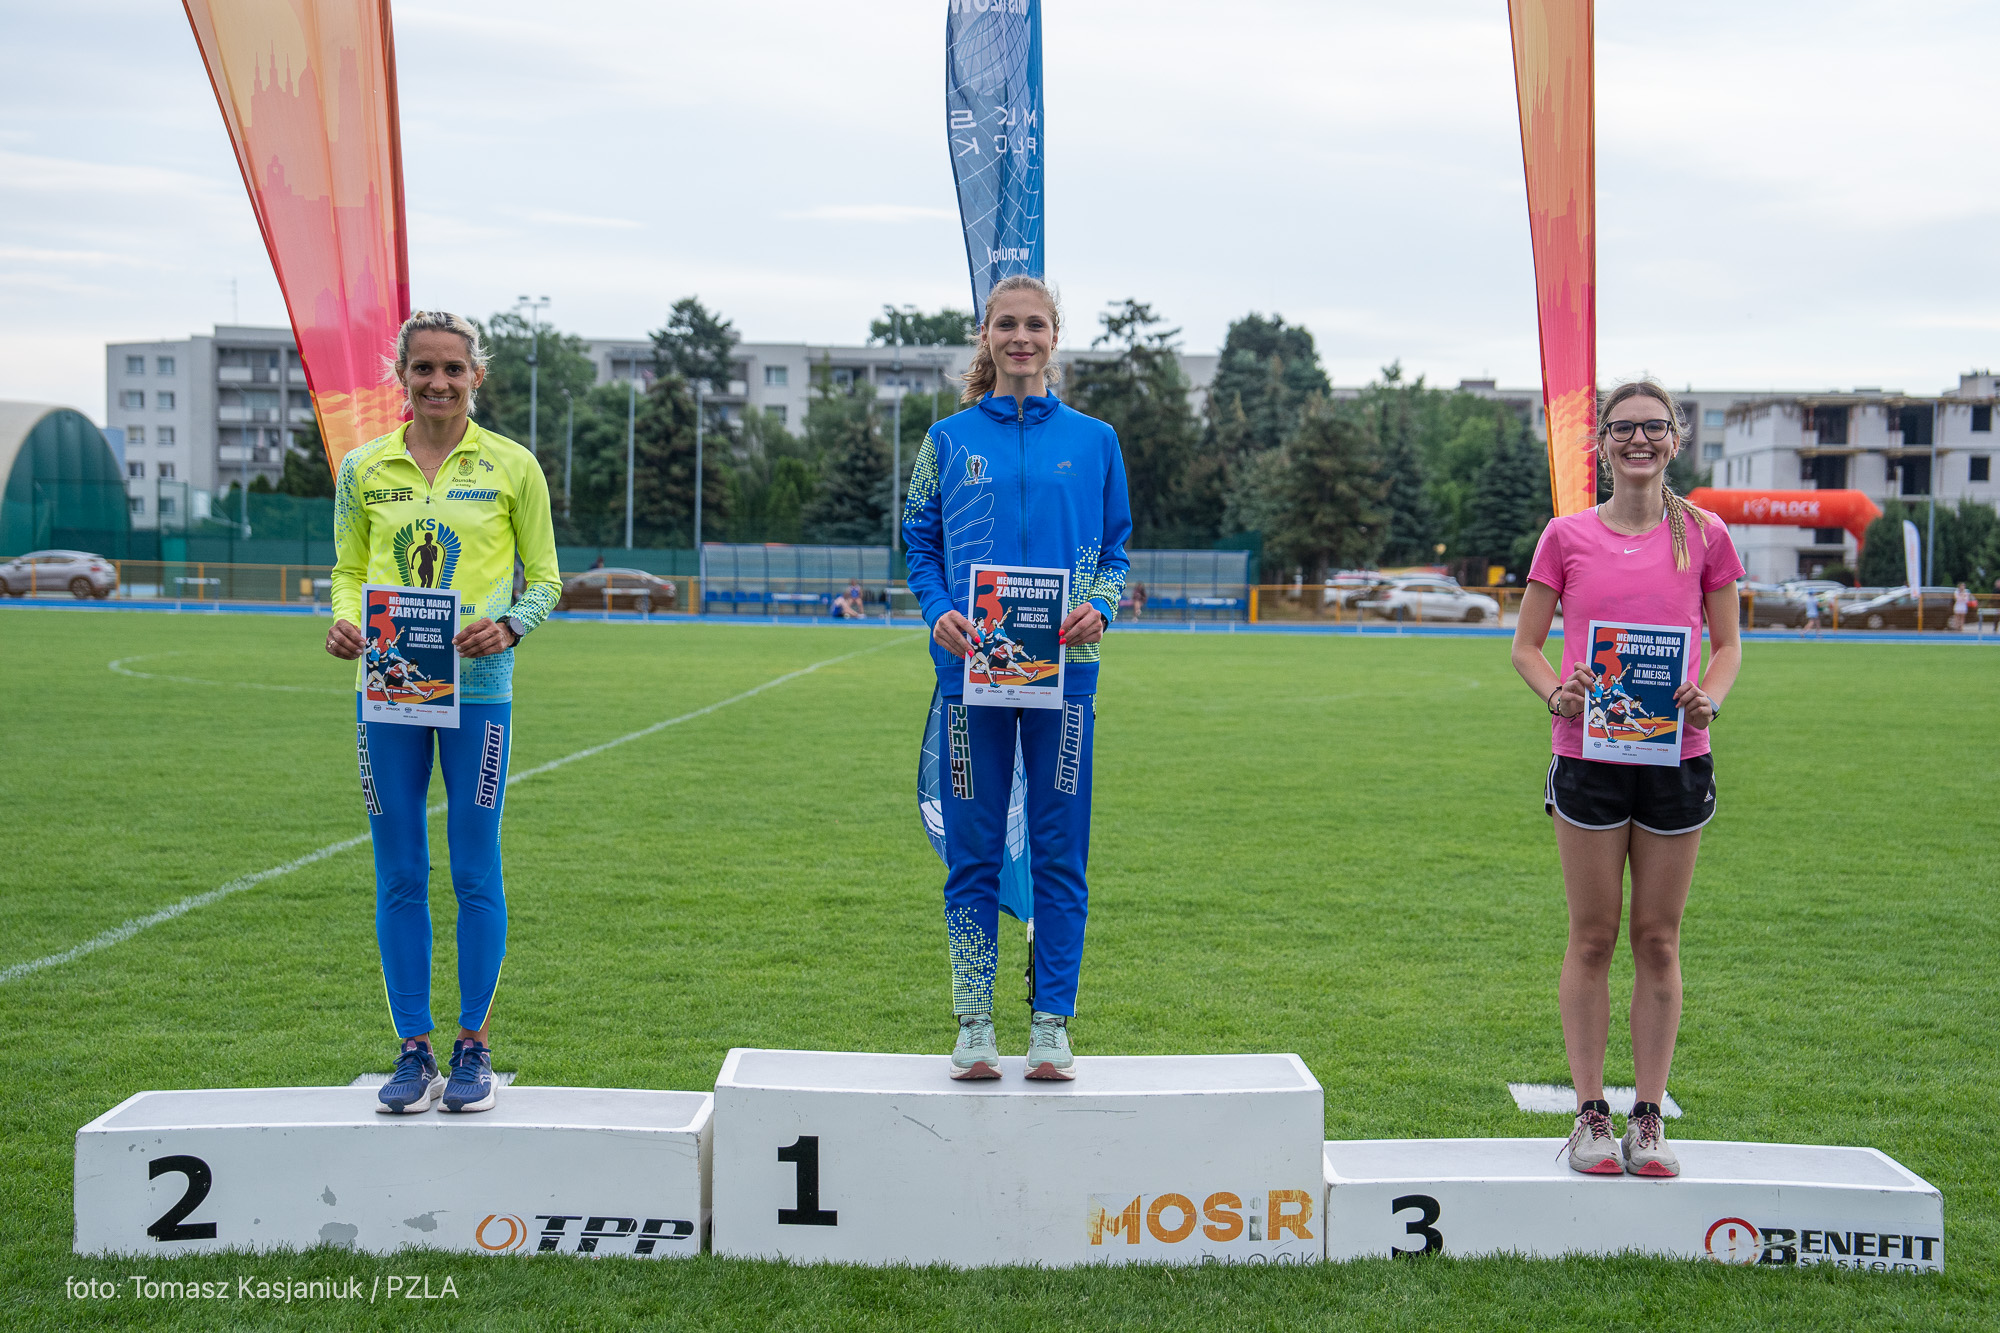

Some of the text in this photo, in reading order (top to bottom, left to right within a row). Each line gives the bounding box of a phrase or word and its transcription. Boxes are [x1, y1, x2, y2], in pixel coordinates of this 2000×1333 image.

[363, 487, 413, 505] PREFBET
[446, 489, 501, 502] SONAROL
[415, 519, 436, 531] KS
[996, 576, 1059, 588] MEMORIAŁ MARKA
[996, 586, 1059, 600] ZARYCHTY
[389, 596, 451, 608] MEMORIAŁ MARKA
[389, 606, 451, 620] ZARYCHTY
[460, 604, 476, 616] ROL
[1017, 613, 1048, 623] I MIEJSCA
[409, 633, 442, 643] II MIEJSCA
[1616, 633, 1680, 645] MEMORIAŁ MARKA
[1615, 643, 1680, 658] ZARYCHTY
[1642, 670, 1670, 680] MIEJSCA
[949, 705, 974, 799] PREFBET
[1055, 701, 1083, 795] SONAROL
[358, 723, 383, 815] PREFBET
[476, 721, 504, 809] SONAROL
[778, 1136, 837, 1226] 1
[147, 1155, 217, 1242] 2
[1392, 1194, 1443, 1258] 3
[535, 1215, 694, 1254] TPP
[1758, 1228, 1940, 1265] BENEFIT
